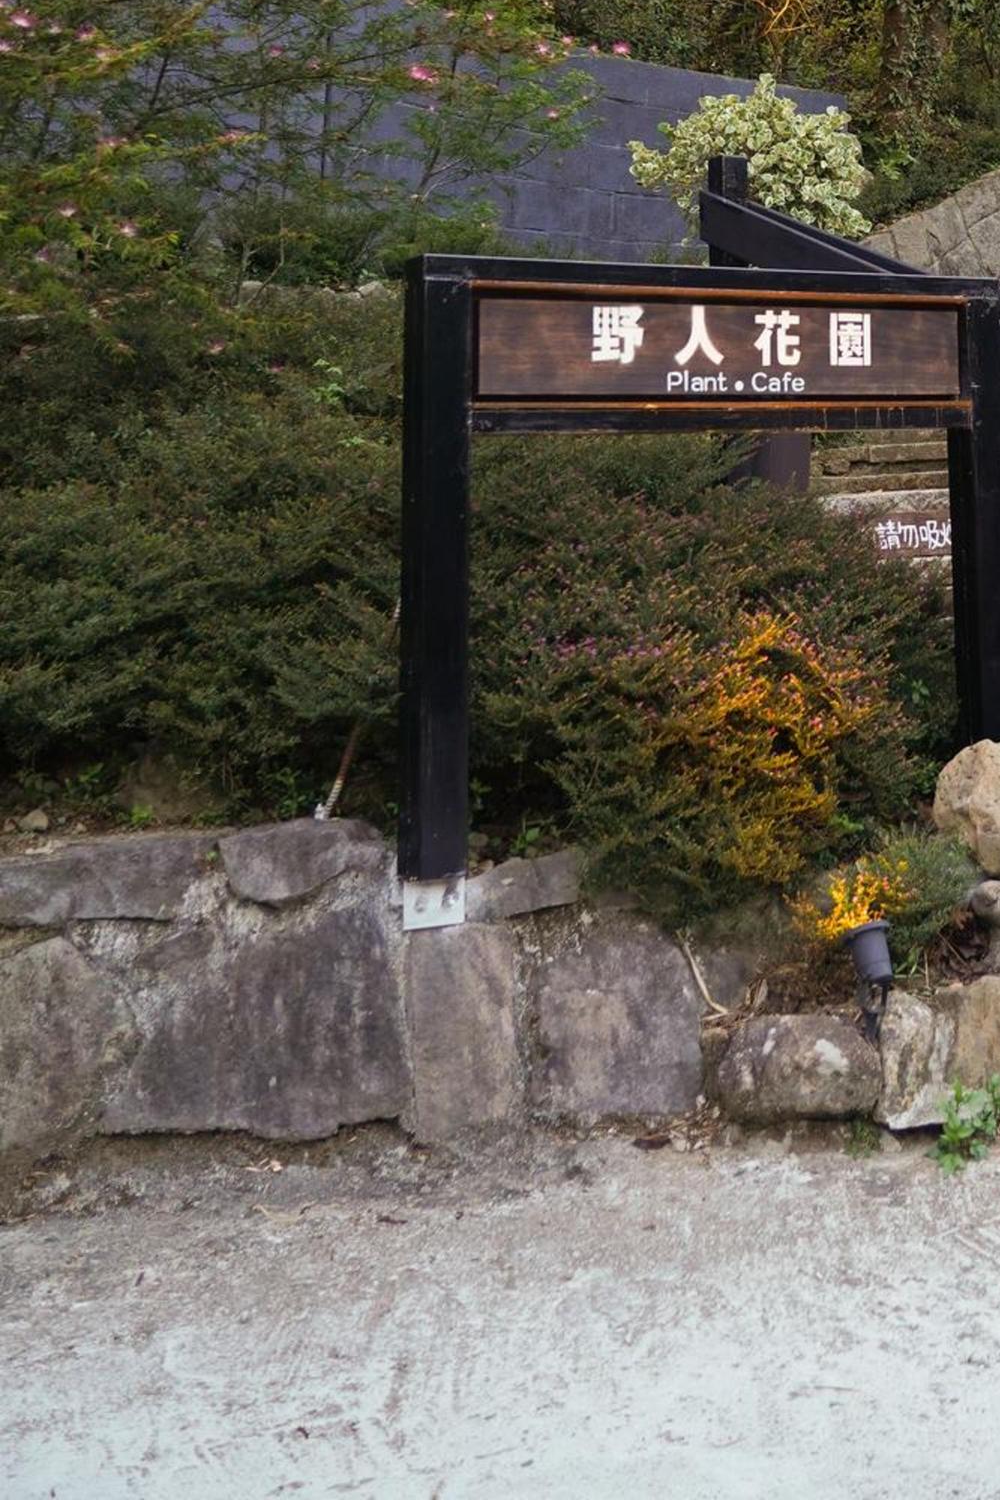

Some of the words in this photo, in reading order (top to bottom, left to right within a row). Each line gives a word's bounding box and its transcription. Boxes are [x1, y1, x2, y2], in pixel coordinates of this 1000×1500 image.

[591, 305, 872, 367] 野人花園
[666, 370, 728, 393] Plant
[751, 371, 806, 393] Cafe
